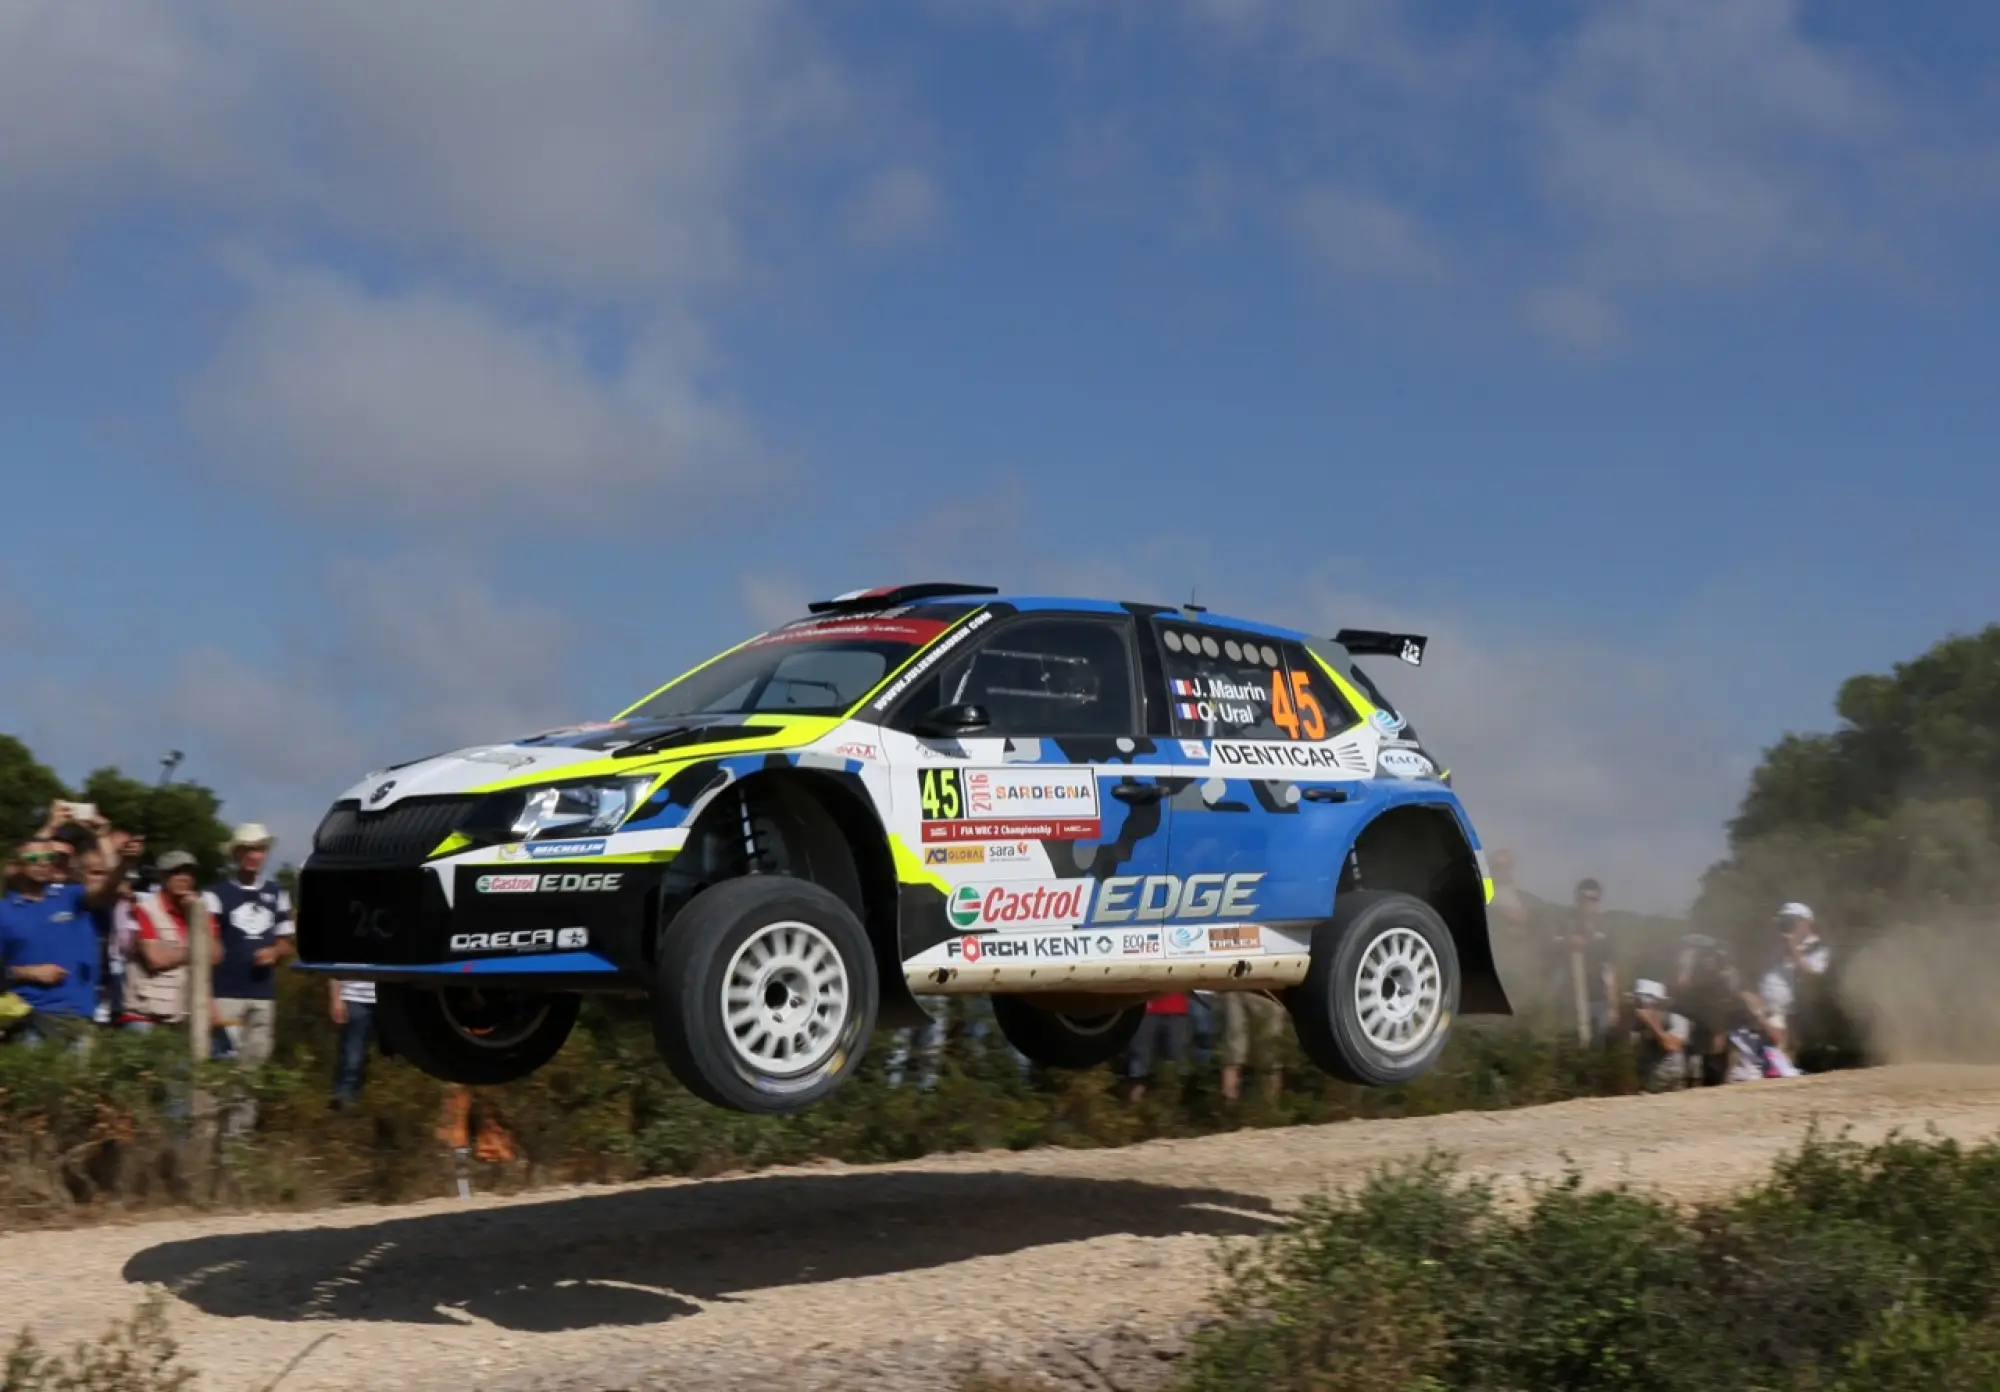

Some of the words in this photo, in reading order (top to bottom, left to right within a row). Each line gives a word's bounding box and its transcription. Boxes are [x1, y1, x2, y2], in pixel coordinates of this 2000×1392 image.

[1192, 678, 1207, 698] J.
[1208, 680, 1266, 700] Maurin
[1198, 702, 1217, 723] O.
[1219, 704, 1254, 723] Ural
[1272, 670, 1325, 740] 45
[1214, 744, 1340, 768] IDENTICAR
[922, 768, 959, 818] 45
[969, 773, 992, 812] 2016
[995, 785, 1091, 800] SARDEGNA
[960, 826, 974, 836] FIA
[994, 826, 999, 835] 2
[1001, 824, 1052, 836] Championship
[533, 843, 605, 855] MICHELIN
[948, 849, 984, 860] GLOBAL
[989, 845, 1015, 857] sara
[491, 877, 535, 890] Castrol
[538, 873, 624, 892] EDGE
[983, 884, 1083, 922] Castrol
[1091, 873, 1267, 922] EDGE
[450, 929, 554, 950] ORECA
[1034, 936, 1091, 956] KENT
[1123, 934, 1144, 948] ECO
